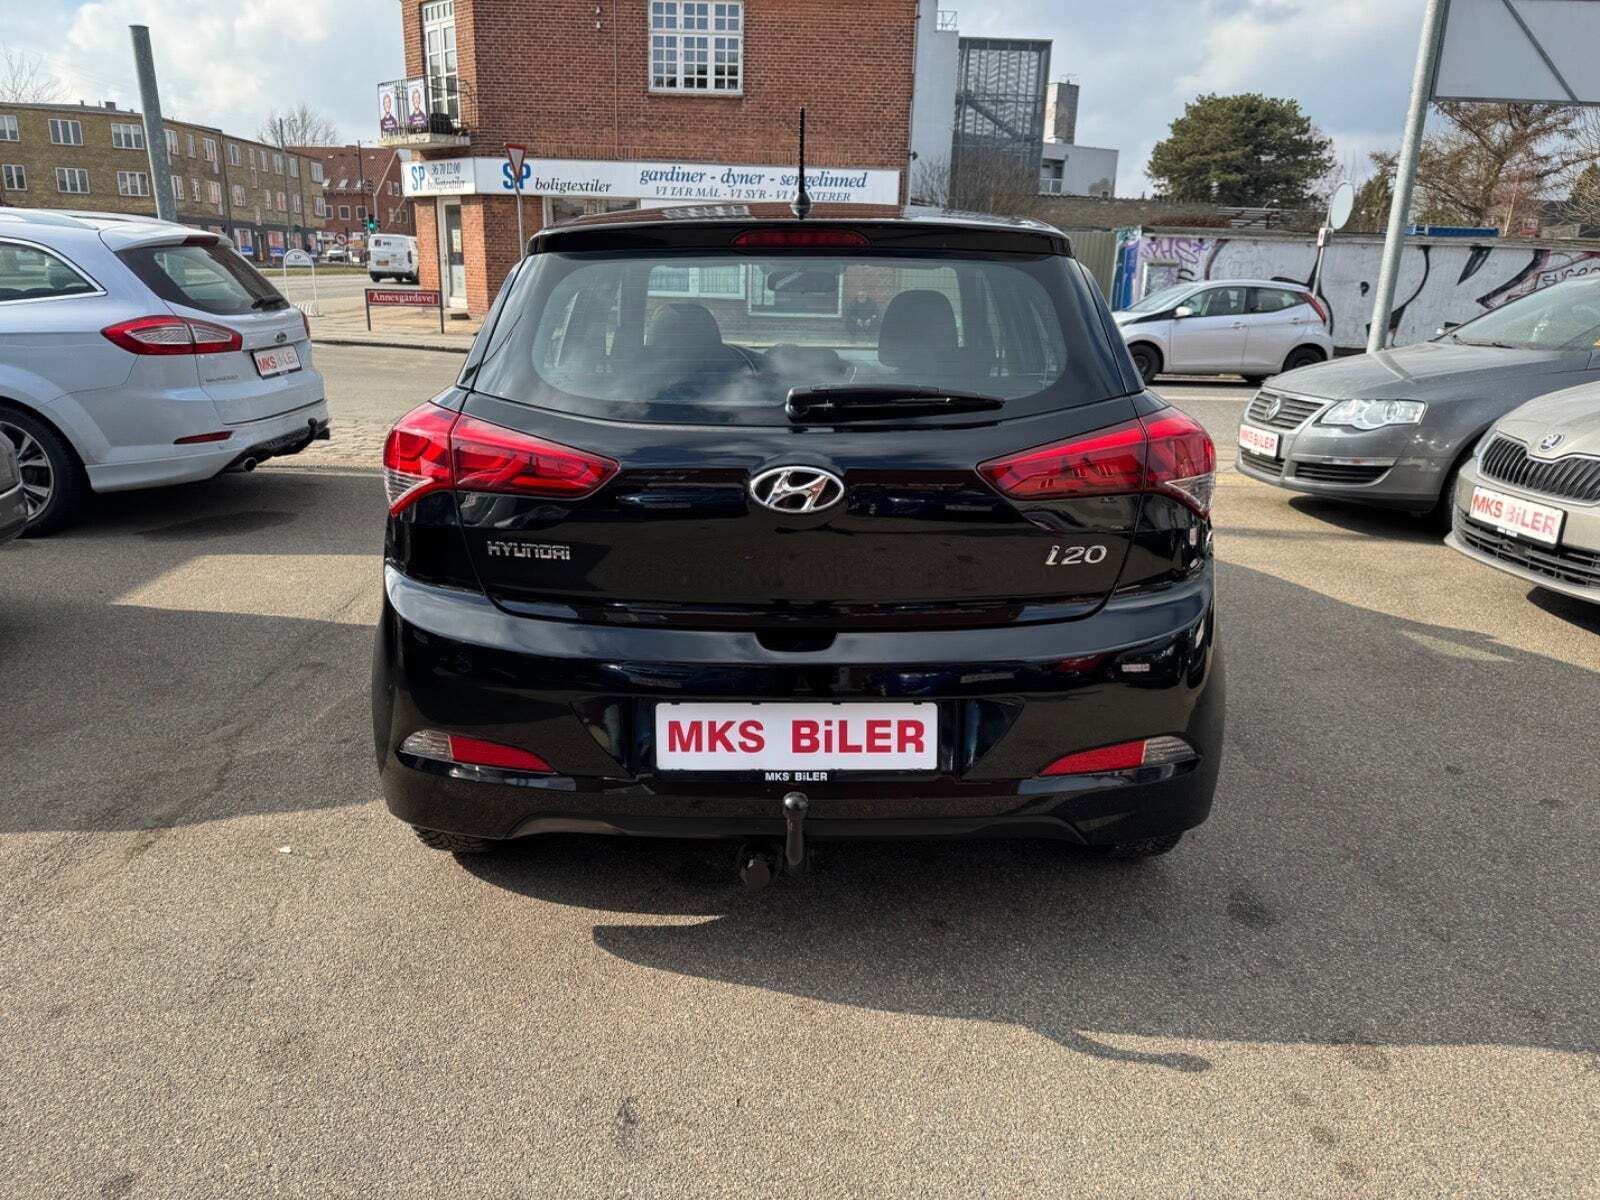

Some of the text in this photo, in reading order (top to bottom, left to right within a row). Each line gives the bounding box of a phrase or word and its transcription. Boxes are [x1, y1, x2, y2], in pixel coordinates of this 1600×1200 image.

[411, 165, 425, 191] SP
[535, 177, 612, 194] boligtextiler
[640, 166, 706, 185] gardiner
[720, 168, 765, 188] dyner
[656, 186, 667, 196] VI
[731, 188, 742, 199] VI
[776, 190, 788, 200] VI
[790, 190, 851, 202] MNTERER
[1472, 494, 1556, 536] MKS BiLER
[487, 540, 570, 560] HYUNDAI
[1045, 545, 1108, 565] i20
[667, 719, 925, 753] MKS BiLER
[765, 772, 828, 781] MKS BiLER
